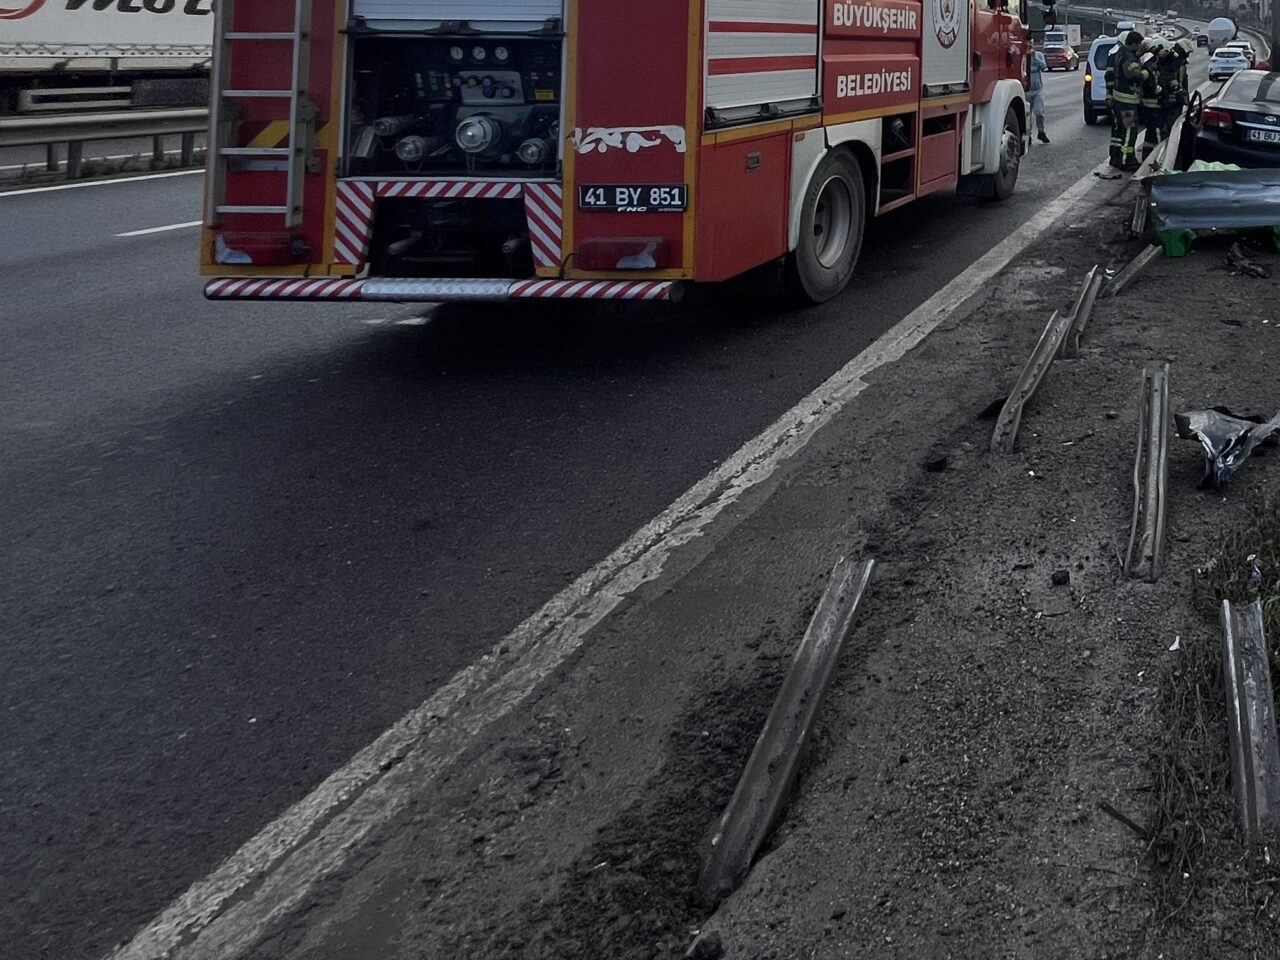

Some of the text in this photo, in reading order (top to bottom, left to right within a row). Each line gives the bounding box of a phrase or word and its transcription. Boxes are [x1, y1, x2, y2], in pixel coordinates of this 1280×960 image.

[833, 0, 916, 33] BÜYÜKŞEHİR
[836, 67, 911, 98] BELEDİYESİ
[1251, 130, 1261, 139] 41
[585, 188, 682, 205] 41 BY 851
